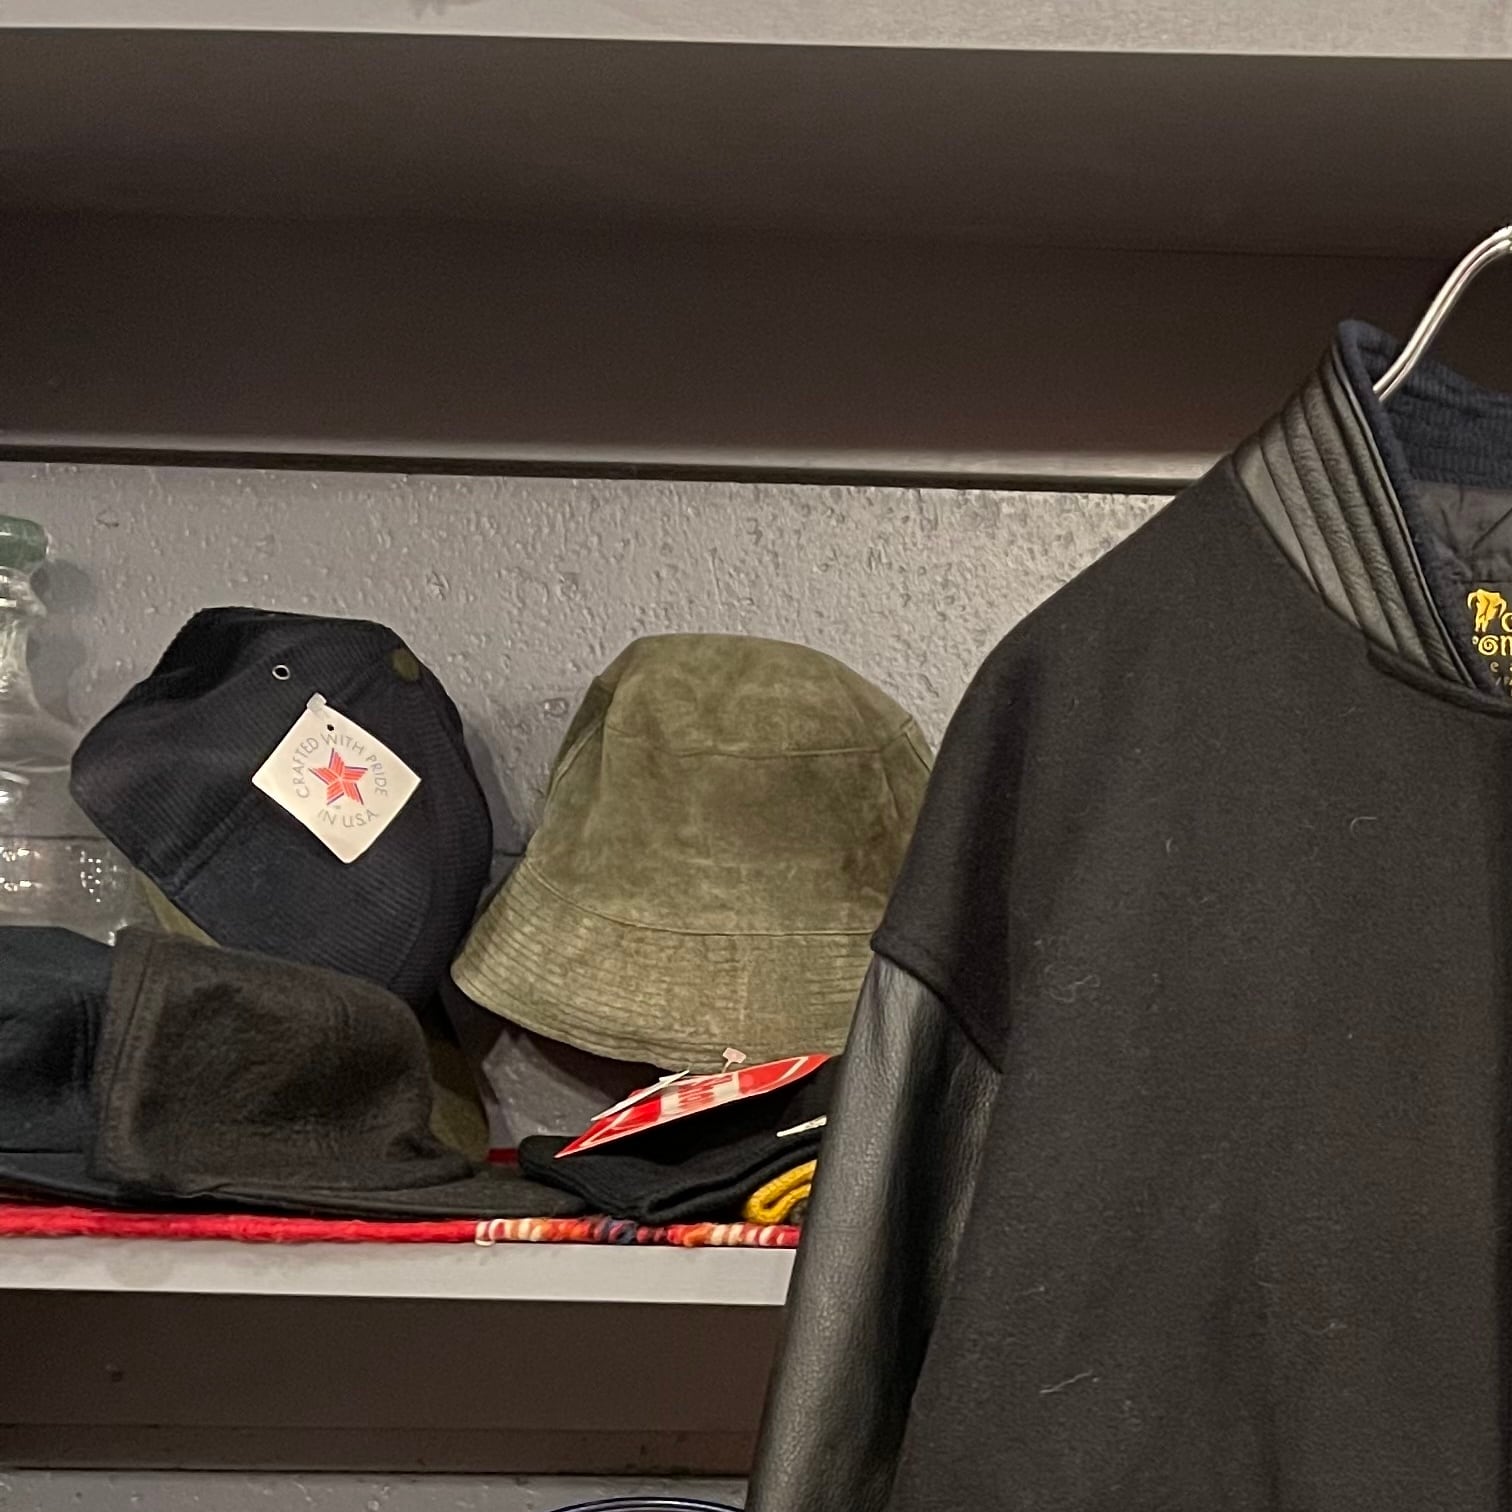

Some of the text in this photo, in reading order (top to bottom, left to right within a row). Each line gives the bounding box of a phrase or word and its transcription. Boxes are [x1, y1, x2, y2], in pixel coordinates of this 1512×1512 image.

[293, 733, 388, 798] CRAFTED WITH PRIDE
[317, 808, 337, 826] IN
